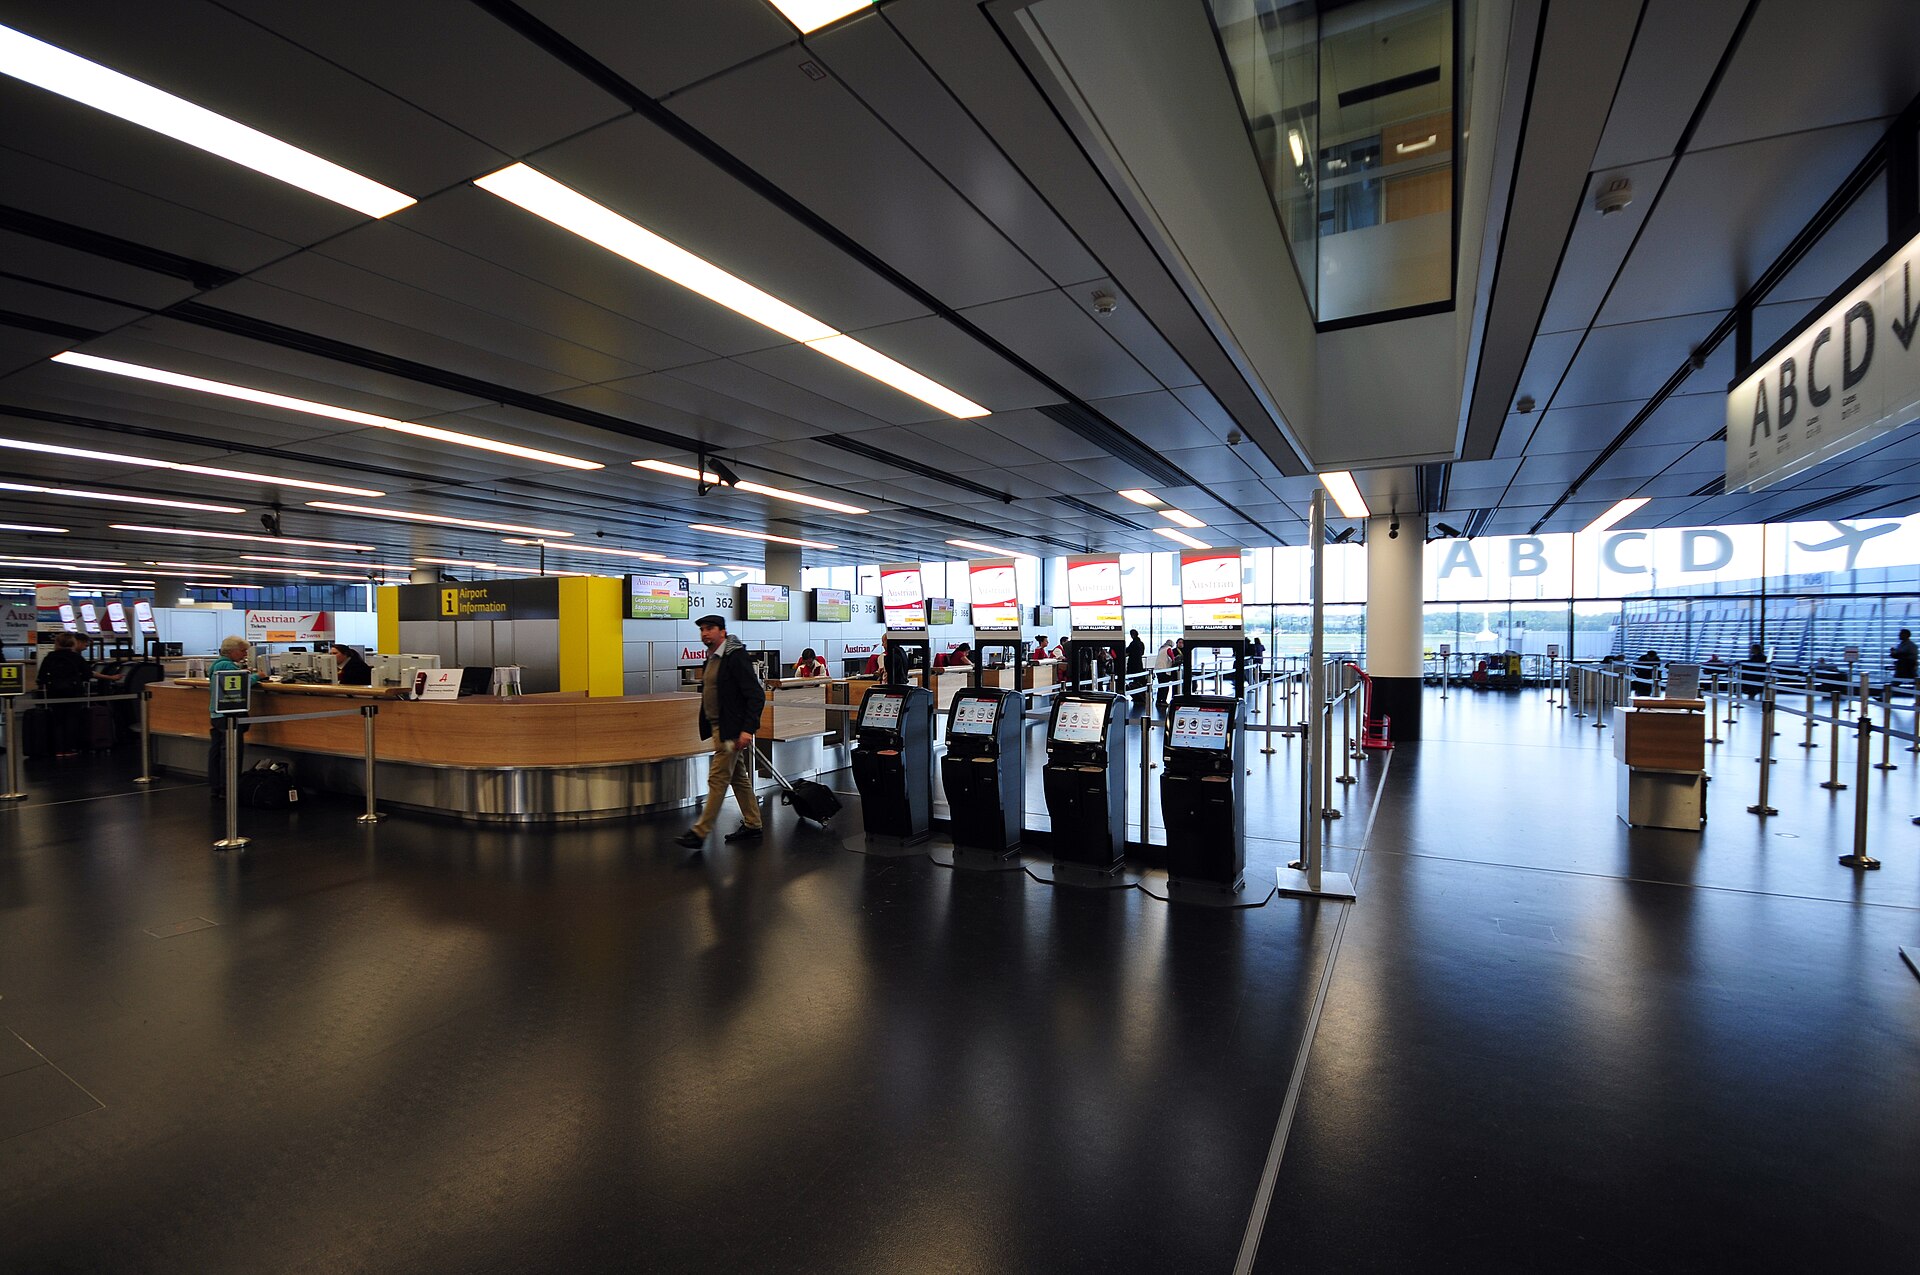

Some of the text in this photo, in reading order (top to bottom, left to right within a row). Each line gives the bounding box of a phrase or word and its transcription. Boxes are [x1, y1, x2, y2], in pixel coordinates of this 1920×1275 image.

[1439, 529, 1734, 578] A B C D
[637, 578, 663, 587] Austrian
[459, 588, 488, 601] Airport
[888, 589, 918, 597] Austrian
[460, 602, 506, 614] Information
[716, 597, 733, 609] 362
[251, 614, 295, 623] Austrian
[681, 647, 709, 660] Aust
[844, 644, 871, 653] Austrian
